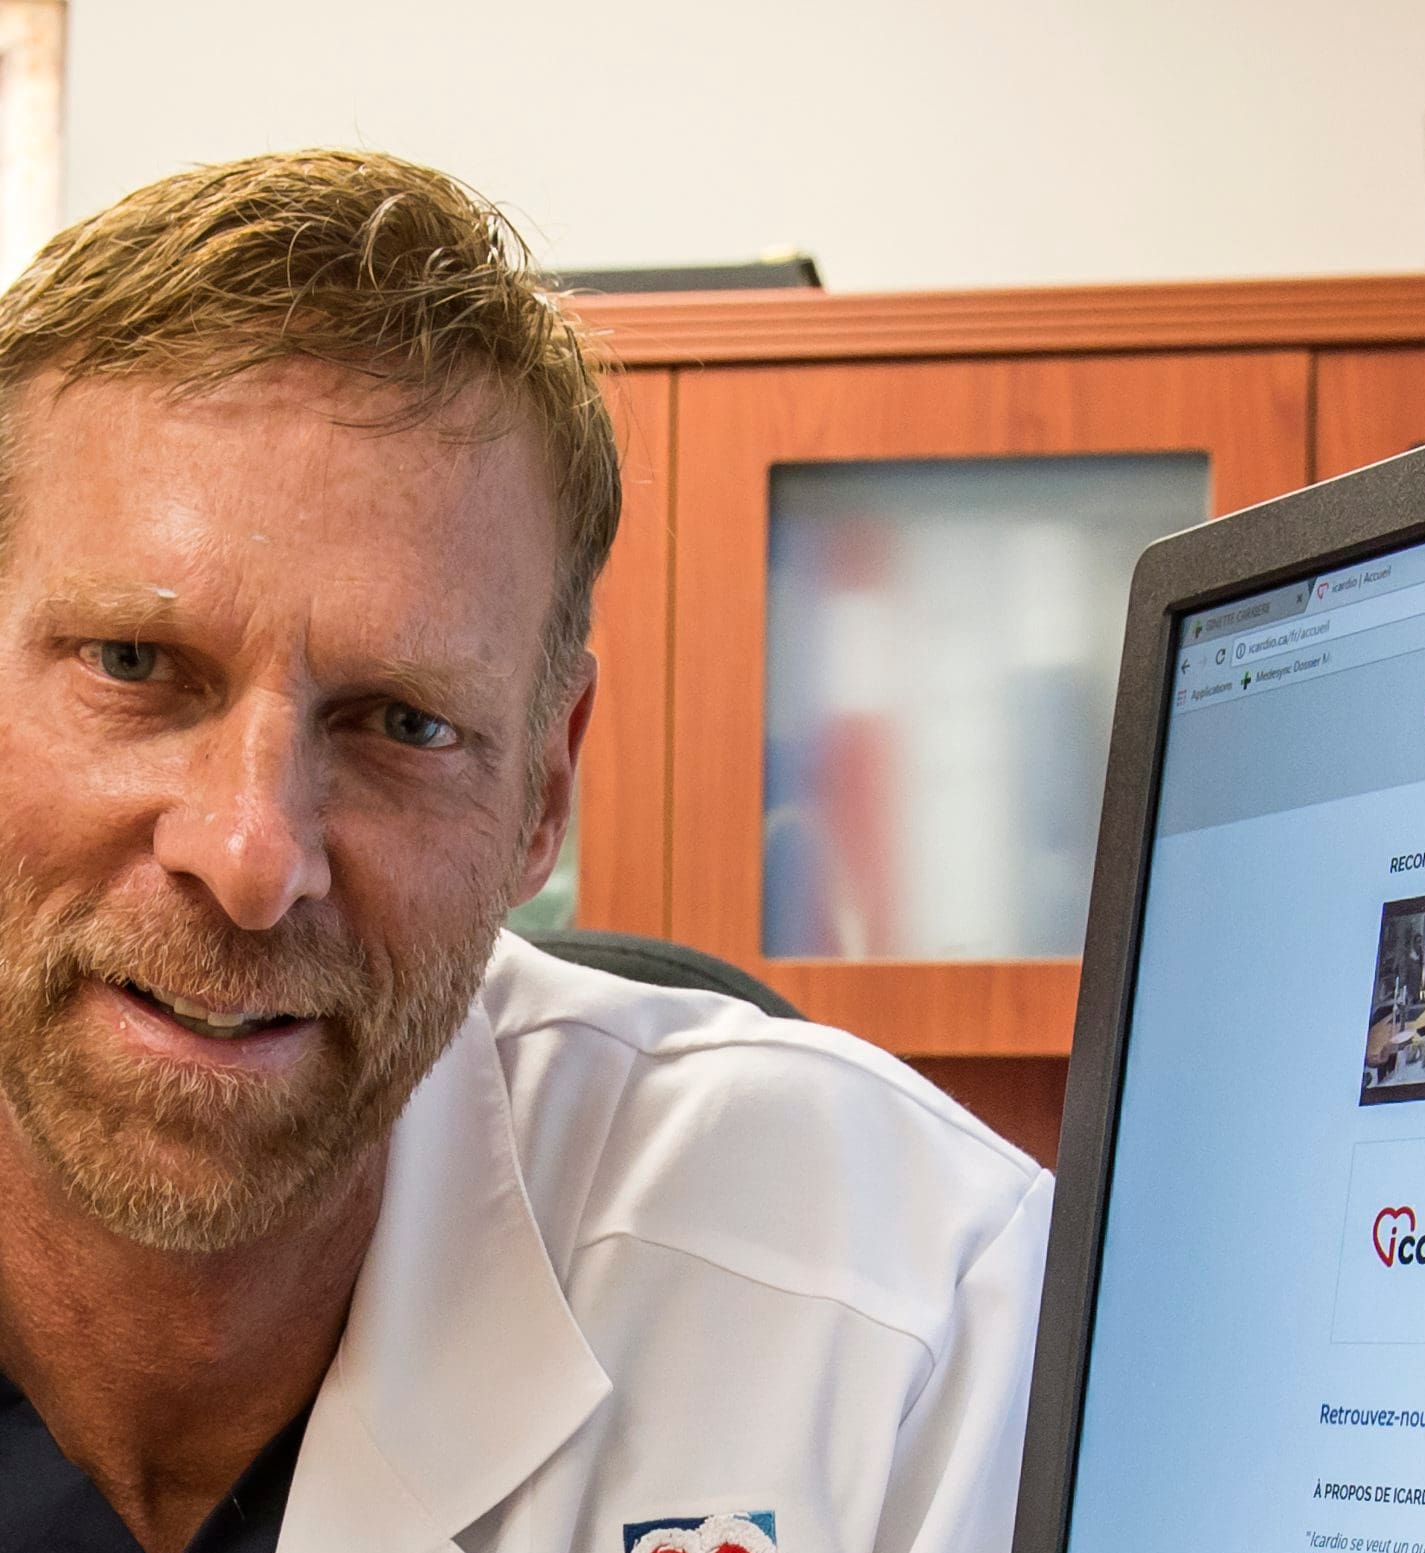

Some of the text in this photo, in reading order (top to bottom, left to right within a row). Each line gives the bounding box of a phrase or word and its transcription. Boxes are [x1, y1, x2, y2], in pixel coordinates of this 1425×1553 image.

[1313, 1478, 1322, 1498] À
[1324, 1482, 1373, 1501] PROPOS
[1374, 1486, 1392, 1503] DE
[1350, 1537, 1364, 1552] se
[1366, 1537, 1391, 1553] veut
